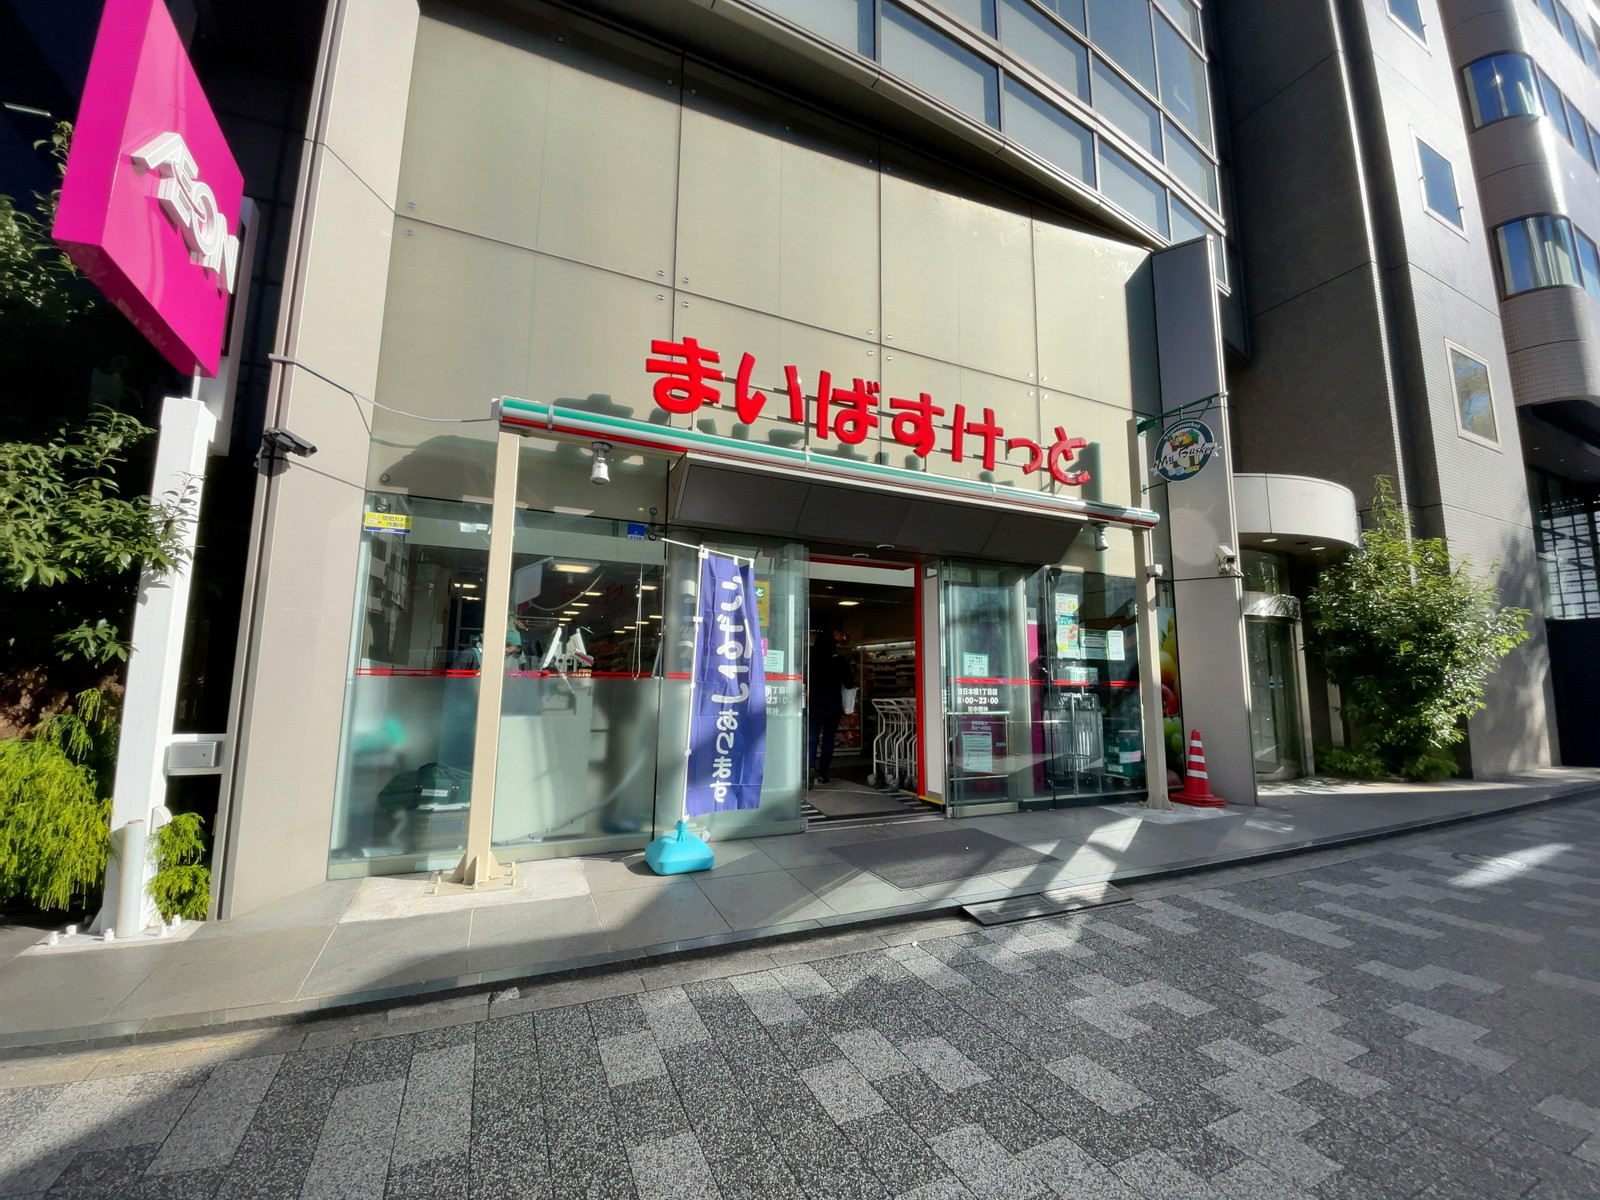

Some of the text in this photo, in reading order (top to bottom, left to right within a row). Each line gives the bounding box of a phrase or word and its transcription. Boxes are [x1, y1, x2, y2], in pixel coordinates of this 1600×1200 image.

[646, 336, 1091, 486] まいばすけっと
